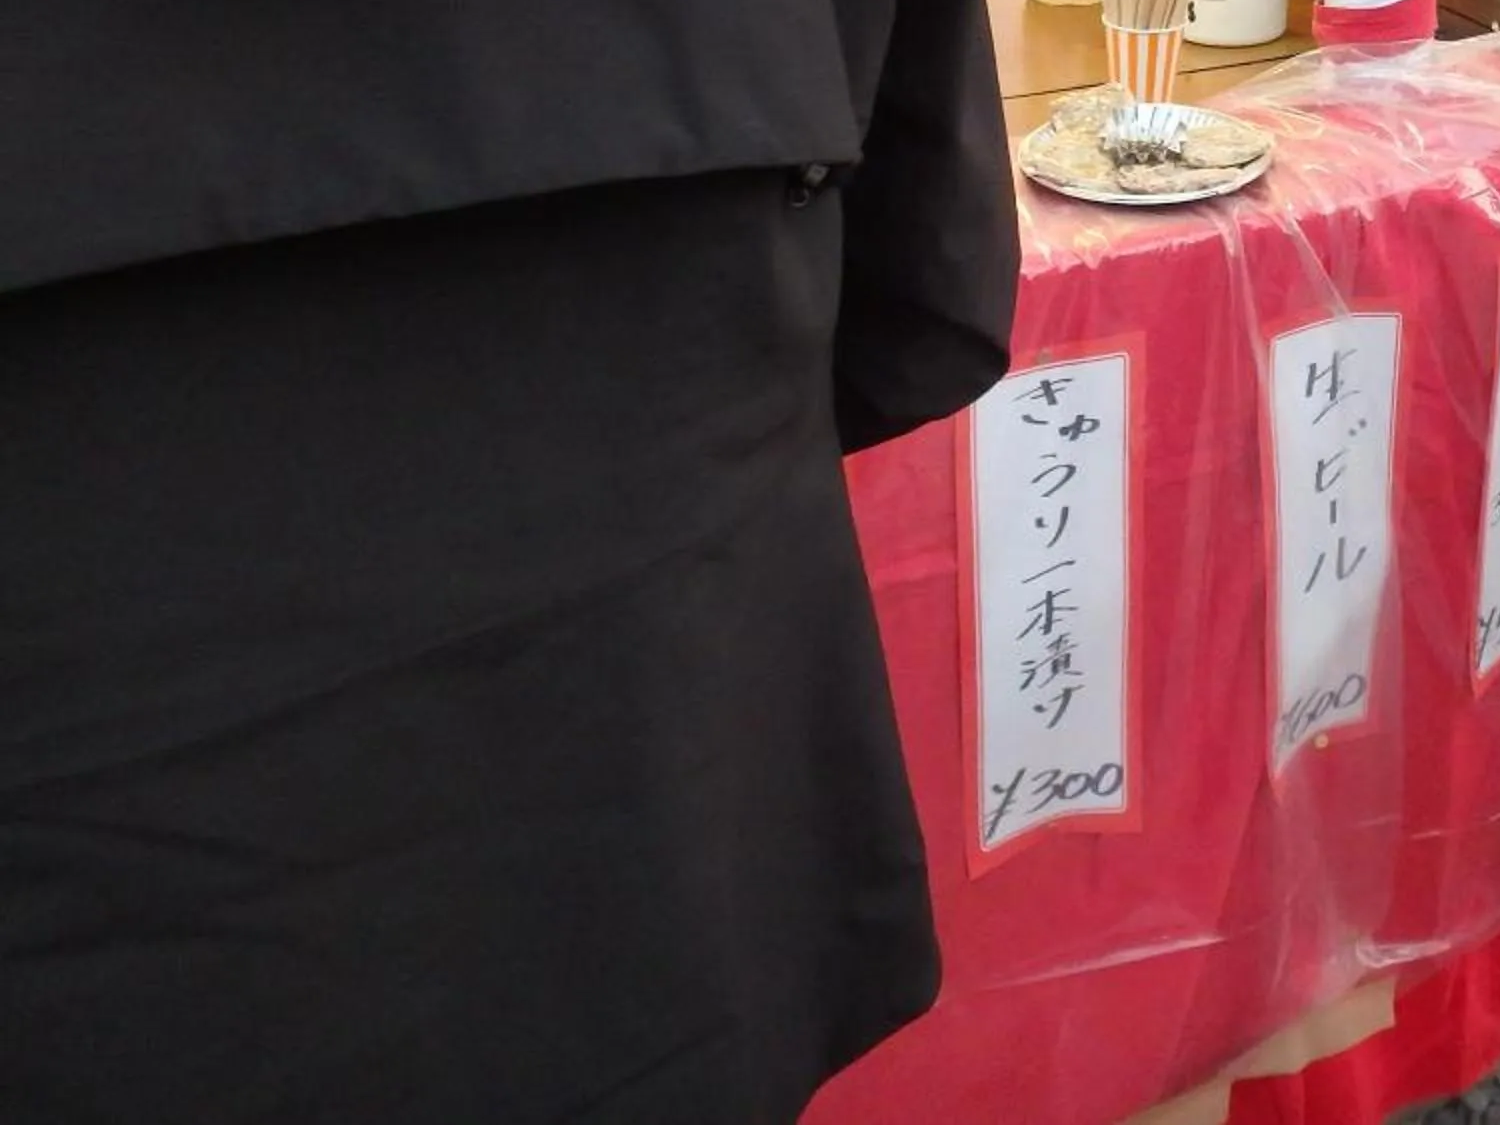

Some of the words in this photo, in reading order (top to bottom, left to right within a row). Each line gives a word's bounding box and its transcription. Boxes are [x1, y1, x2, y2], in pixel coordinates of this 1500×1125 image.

[1011, 377, 1101, 730] きゅうり一本漬け
[1304, 349, 1369, 594] 生ビール
[984, 762, 1124, 842] ¥300
